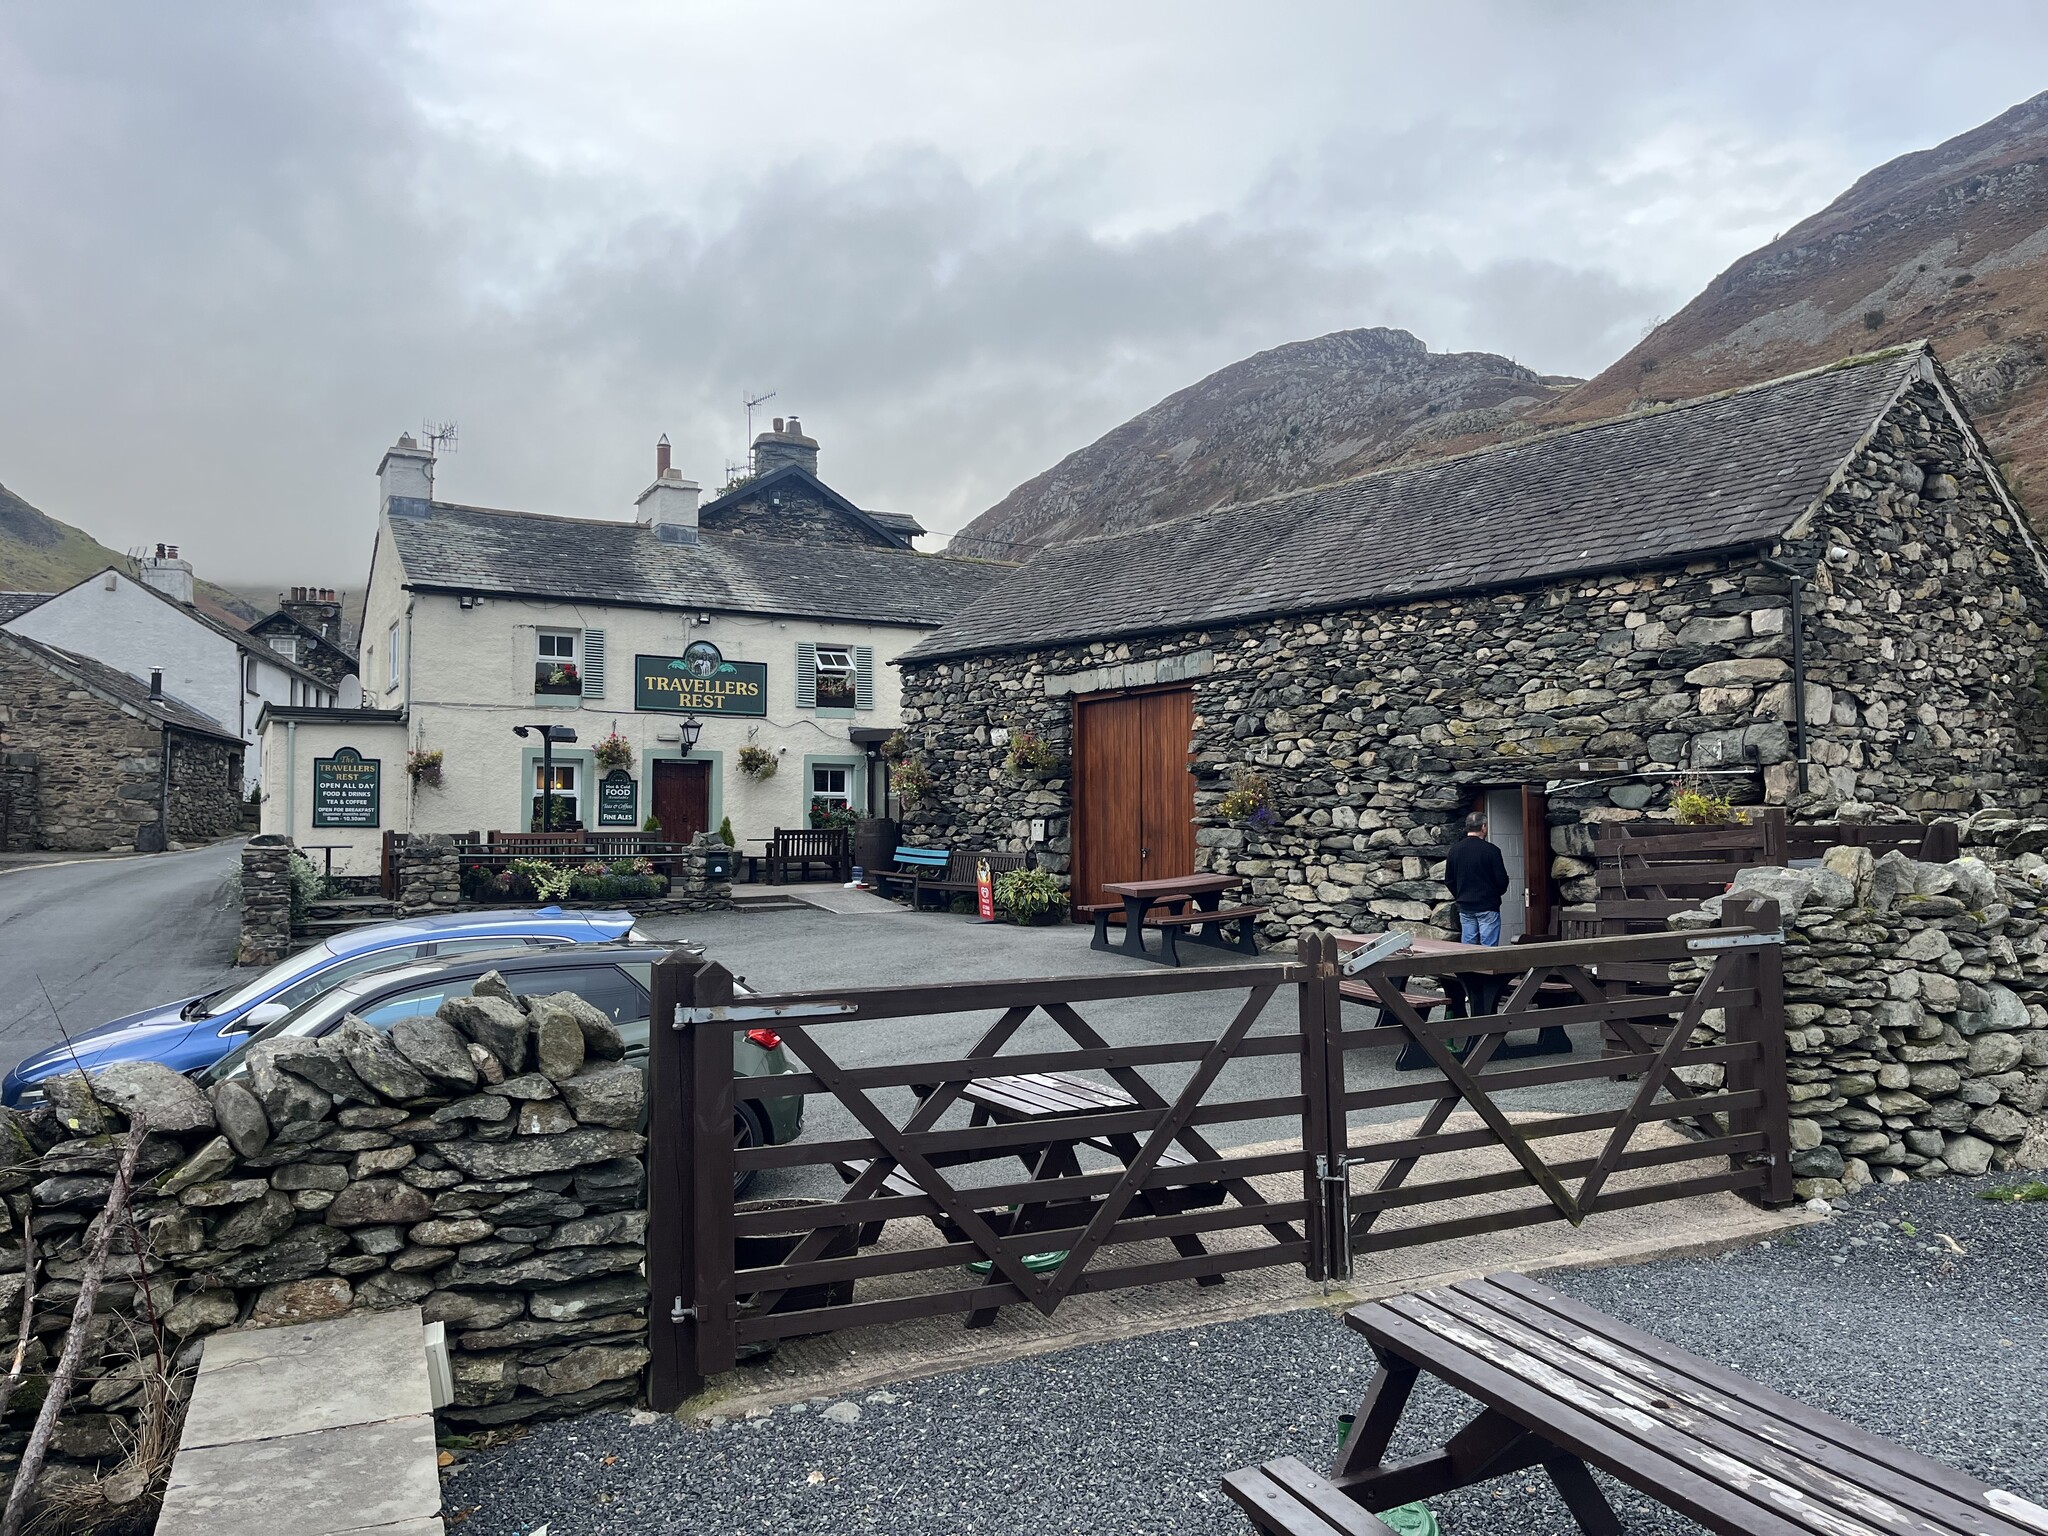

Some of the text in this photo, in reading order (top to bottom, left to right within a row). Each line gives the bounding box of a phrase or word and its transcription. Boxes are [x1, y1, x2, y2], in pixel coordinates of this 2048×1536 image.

[645, 676, 759, 696] TRAVELLERS
[679, 693, 725, 709] REST
[339, 755, 354, 763] The
[336, 773, 359, 781] REST
